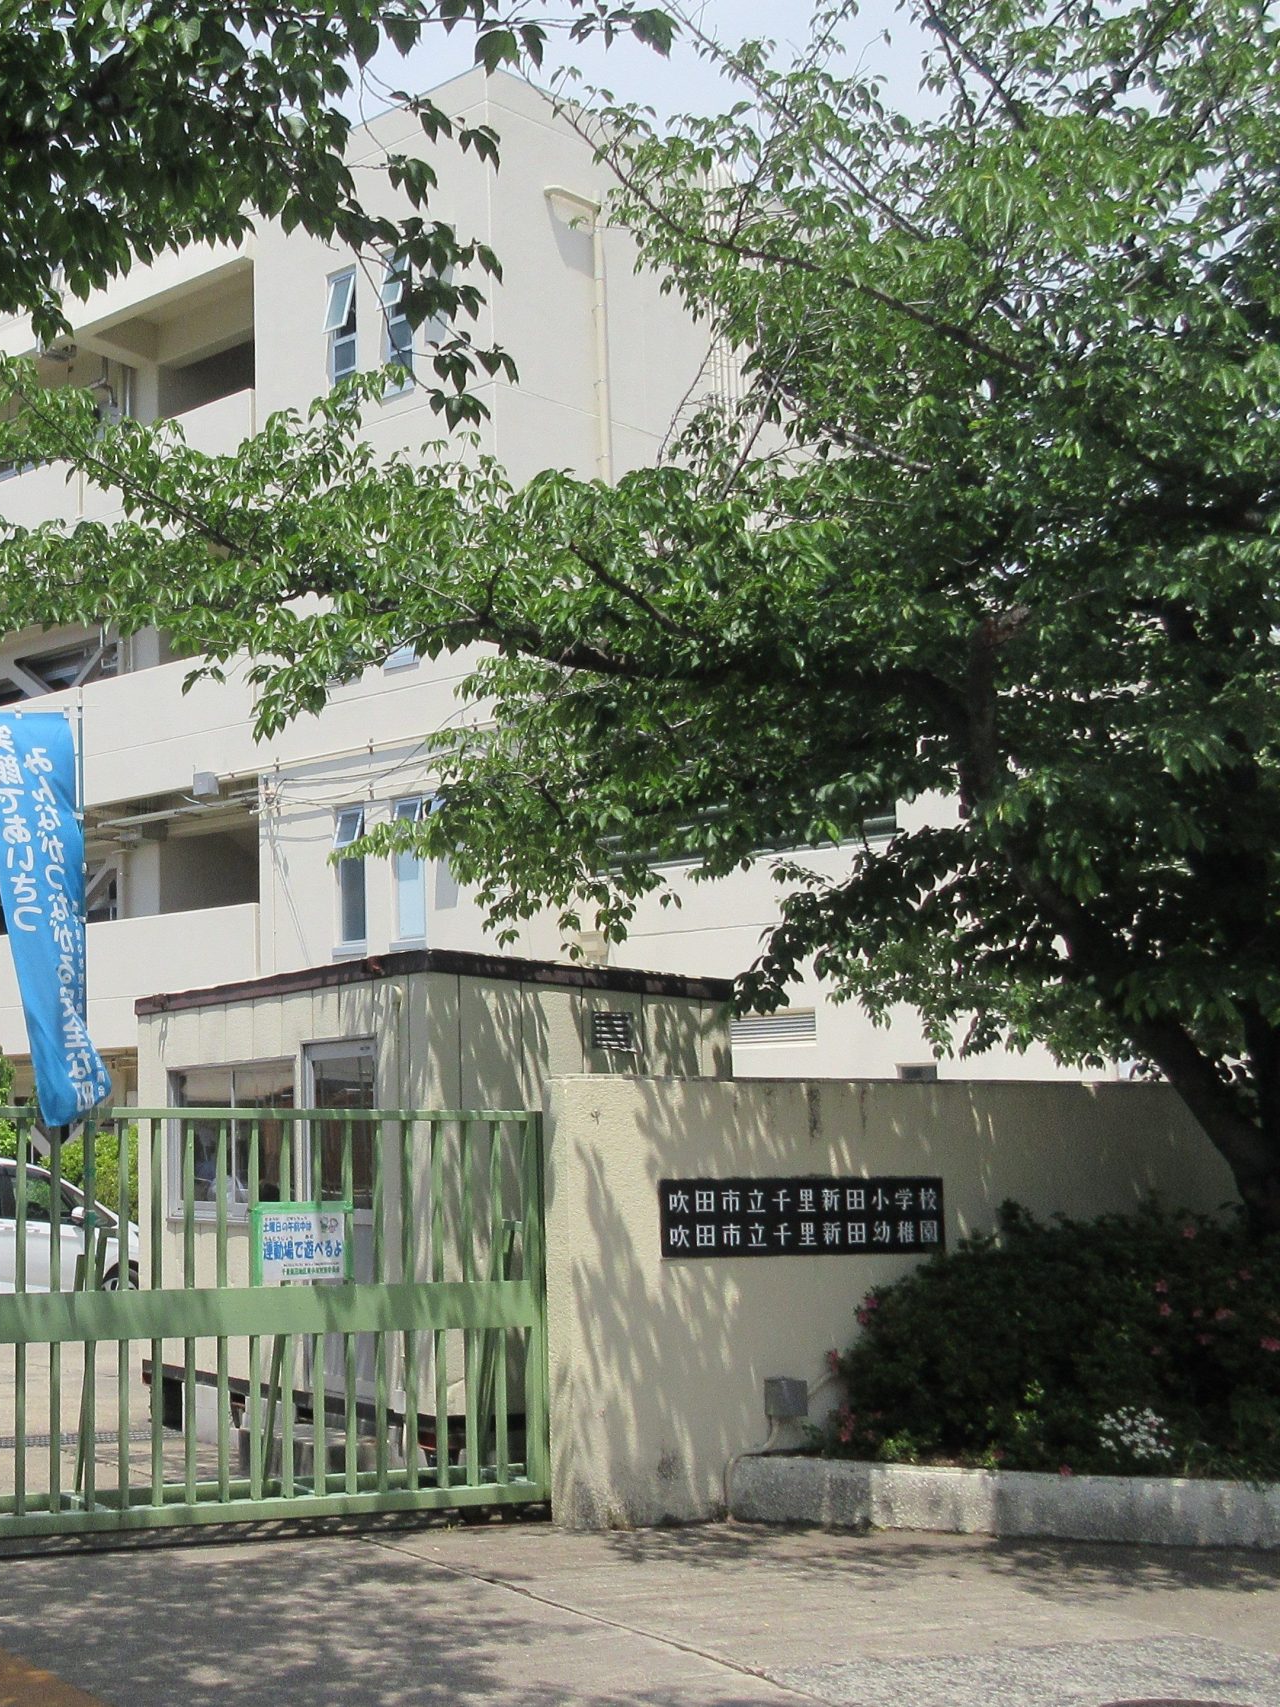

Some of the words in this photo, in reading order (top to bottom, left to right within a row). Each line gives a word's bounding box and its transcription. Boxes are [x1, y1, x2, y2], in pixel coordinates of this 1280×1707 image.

[669, 1188, 938, 1213] 吹田市立千里新田小学校
[669, 1220, 939, 1248] 吹田市立千里新田幼稚園
[263, 1240, 342, 1260] 運動場で遊べるよ
